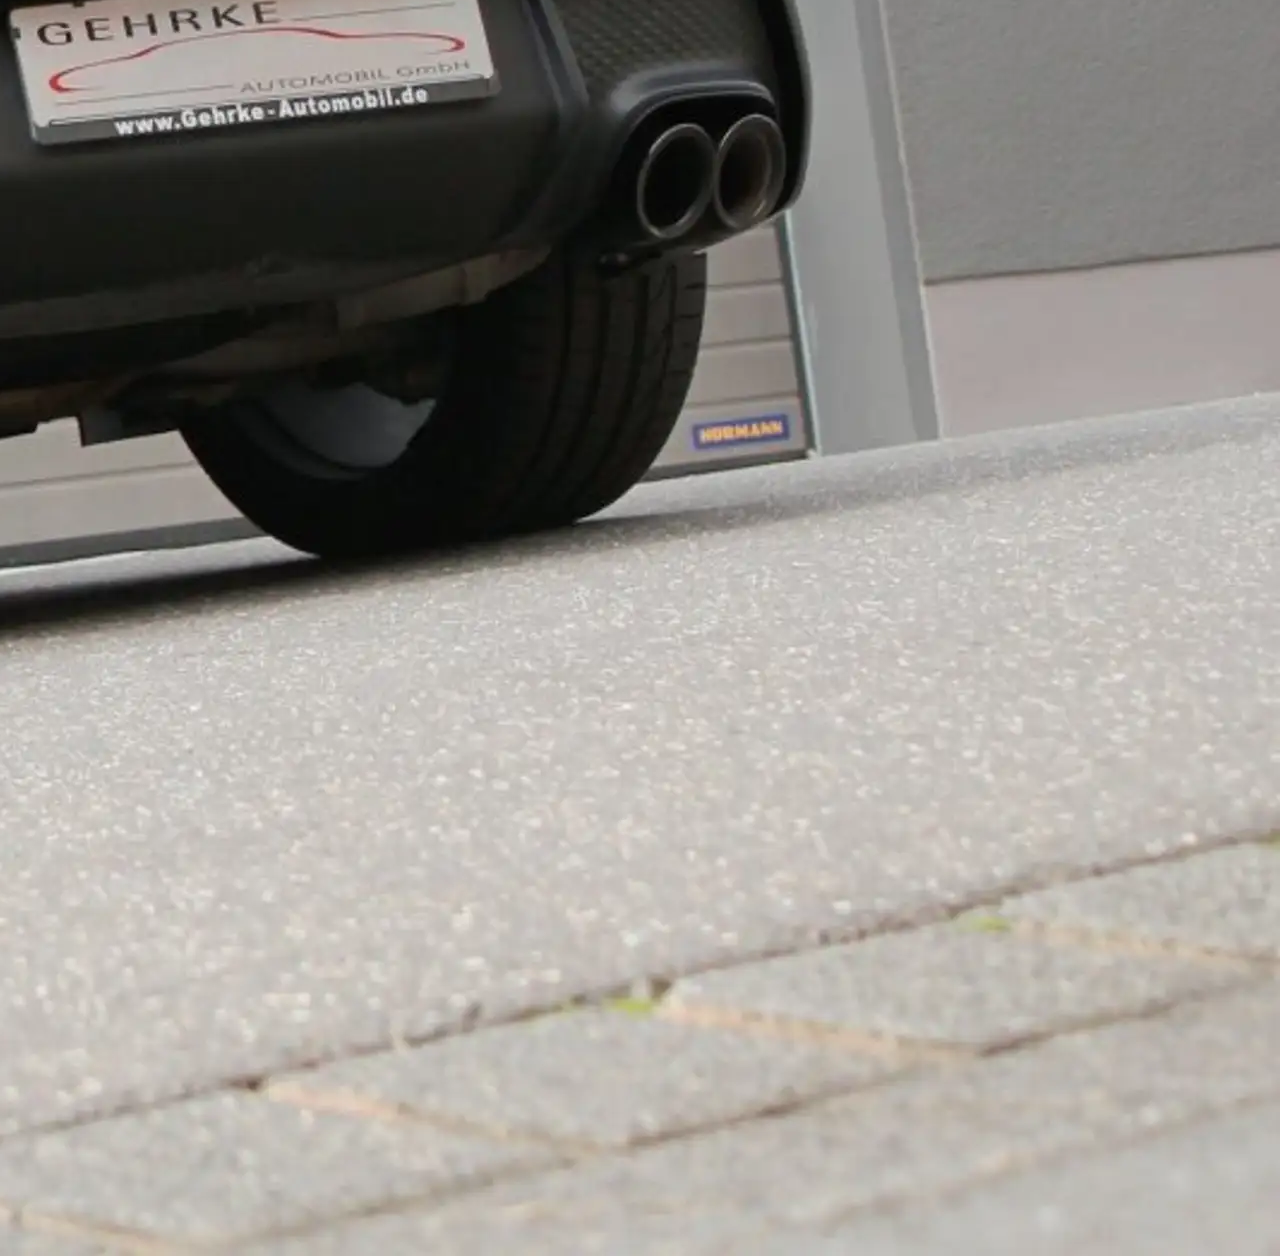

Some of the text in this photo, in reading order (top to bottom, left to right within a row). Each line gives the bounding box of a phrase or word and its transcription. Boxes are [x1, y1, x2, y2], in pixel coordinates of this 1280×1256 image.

[36, 0, 282, 45] GEHRKE
[239, 58, 472, 94] AUTOMOBIL GmbH
[114, 87, 430, 137] www.Gehrke-Automobil.de
